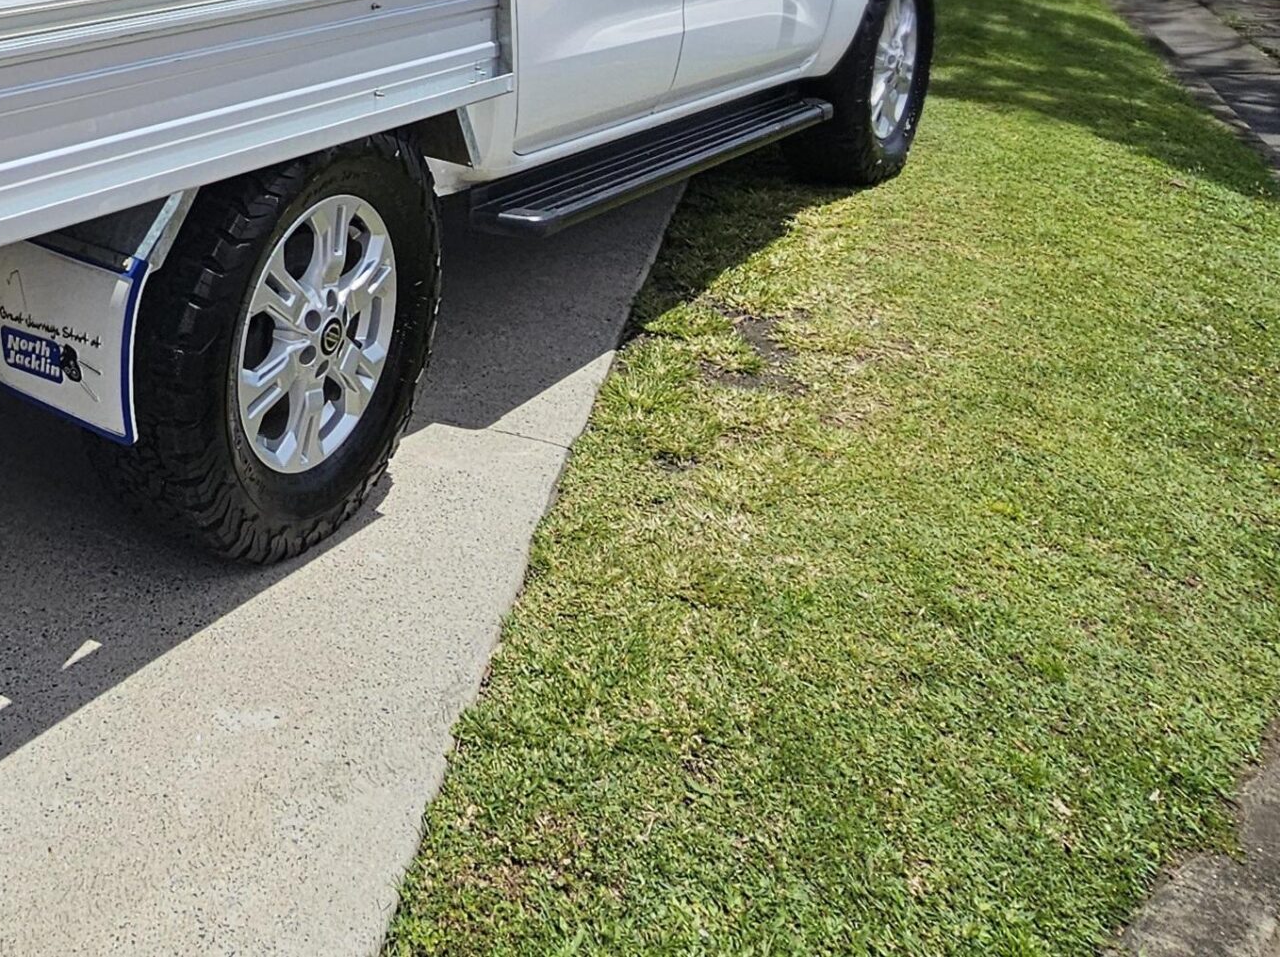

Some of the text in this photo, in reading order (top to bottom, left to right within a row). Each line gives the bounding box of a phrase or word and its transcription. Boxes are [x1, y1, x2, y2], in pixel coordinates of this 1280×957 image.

[0, 305, 24, 324] Great
[62, 326, 89, 344] Start
[90, 336, 102, 349] at
[7, 334, 51, 357] North
[7, 350, 61, 378] Jacklin
